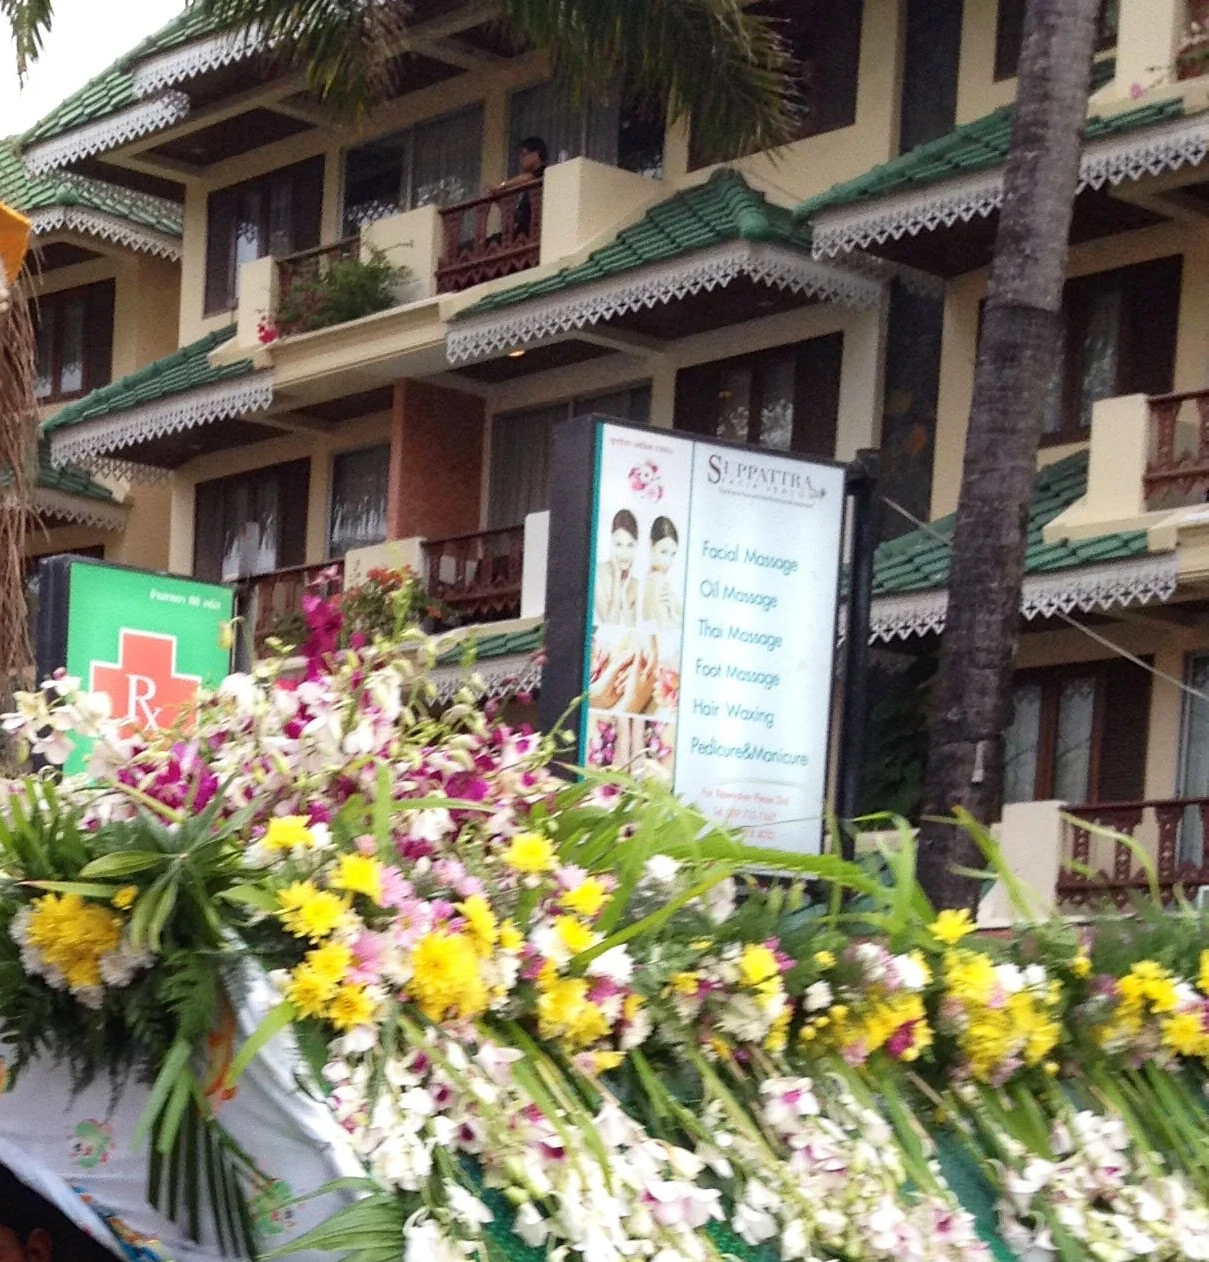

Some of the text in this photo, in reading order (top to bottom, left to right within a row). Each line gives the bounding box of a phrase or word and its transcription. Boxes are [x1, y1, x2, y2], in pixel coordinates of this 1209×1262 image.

[702, 540, 799, 576] Facial Massage
[699, 579, 778, 612] Oil Massage
[697, 618, 783, 652] Thai Massage
[695, 657, 780, 690] Foot Massage
[692, 698, 776, 729] Hair Waxing
